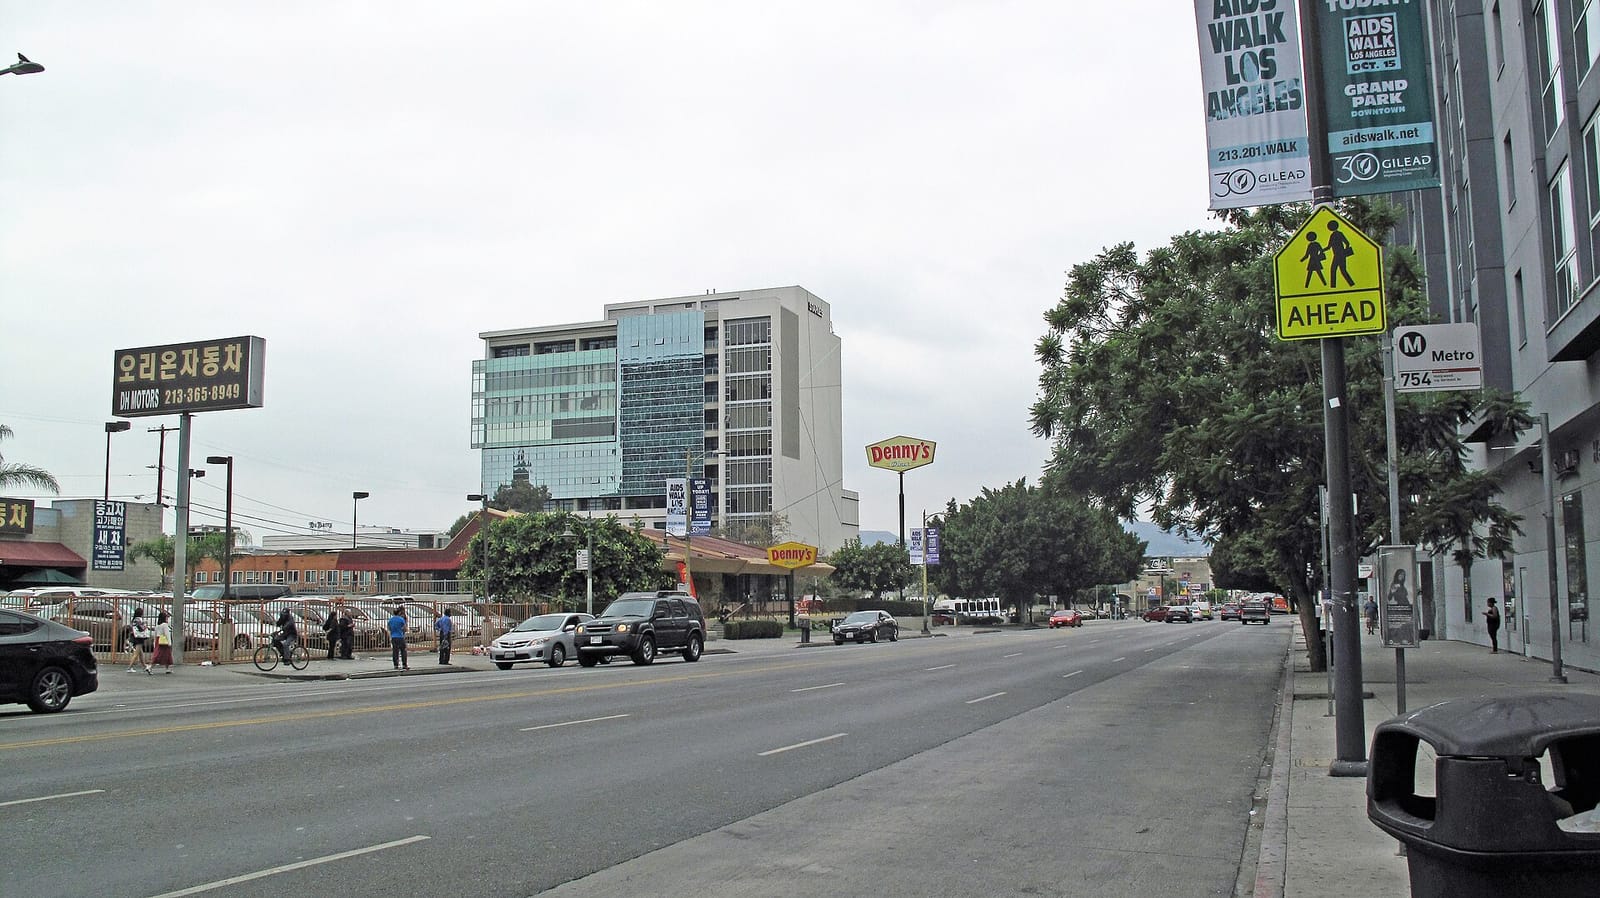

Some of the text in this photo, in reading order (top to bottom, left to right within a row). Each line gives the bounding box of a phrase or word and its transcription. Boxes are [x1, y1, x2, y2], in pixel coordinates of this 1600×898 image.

[1208, 12, 1287, 53] WALK
[1348, 17, 1393, 37] AIDS
[1349, 34, 1394, 51] WALK
[1350, 48, 1396, 60] LOS ANGELES
[1224, 48, 1277, 86] LOS
[1351, 60, 1396, 71] OCT. 15
[1344, 79, 1408, 97] GRAND
[1208, 78, 1302, 122] ANGELES
[1352, 92, 1403, 108] PARK
[1351, 106, 1406, 118] DOWNTOWN
[1343, 127, 1419, 146] aidswalk.net
[1218, 141, 1297, 162] 213.201.WALK
[1381, 155, 1432, 171] GILEAD
[1258, 170, 1306, 183] GILEAD
[1287, 300, 1376, 328] AHEAD
[119, 344, 242, 382] 오리온자동차
[1432, 350, 1474, 362] Metro
[1400, 371, 1432, 388] 754
[120, 392, 130, 410] DH
[130, 389, 159, 410] MOTORS
[871, 442, 930, 462] Denny's
[96, 501, 124, 516] 중고차
[771, 548, 812, 561] Denny's
